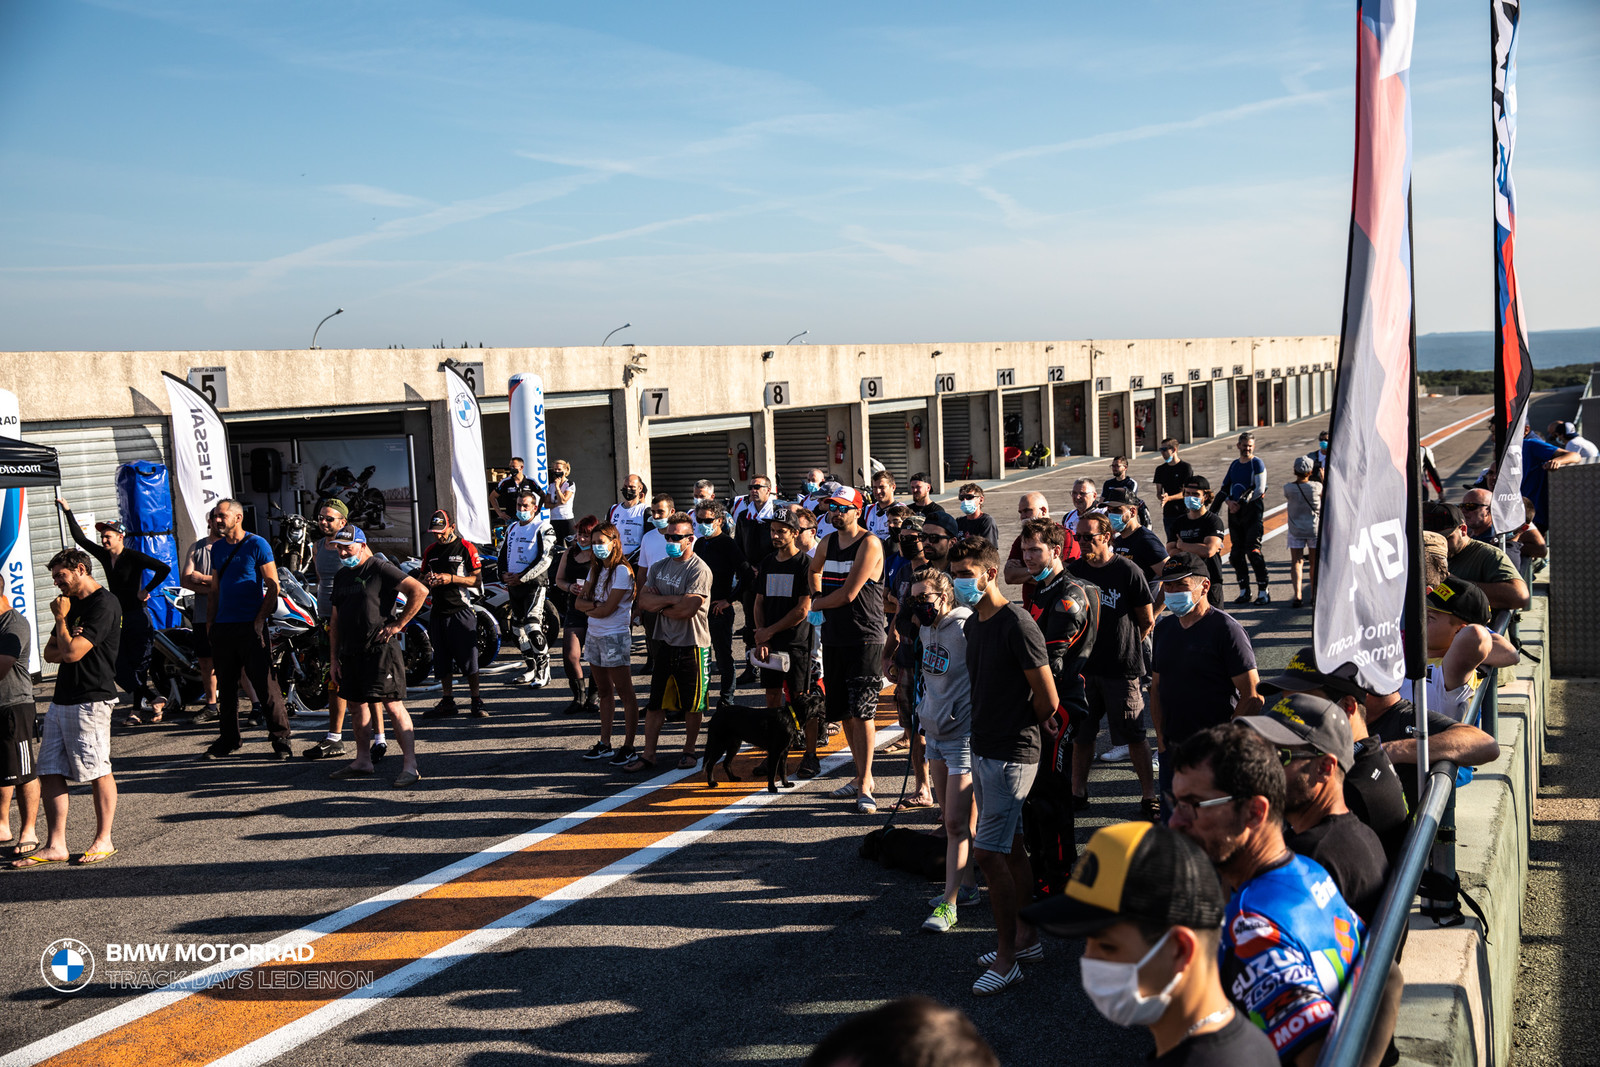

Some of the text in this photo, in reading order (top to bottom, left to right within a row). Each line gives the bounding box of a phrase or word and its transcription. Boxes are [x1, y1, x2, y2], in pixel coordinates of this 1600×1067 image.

[1050, 369, 1063, 381] 12
[1189, 371, 1199, 380] 16
[1213, 368, 1221, 377] 17
[1234, 366, 1243, 374] 18
[1256, 370, 1264, 378] 19
[1272, 369, 1280, 377] 20
[1287, 367, 1295, 375] 21
[464, 367, 475, 393] 6
[1000, 371, 1012, 385] 11
[1131, 378, 1142, 388] 14
[1162, 375, 1173, 384] 15
[202, 374, 216, 405] 5
[868, 380, 877, 397] 9
[939, 377, 954, 391] 10
[773, 385, 783, 404] 8
[652, 393, 663, 414] 7
